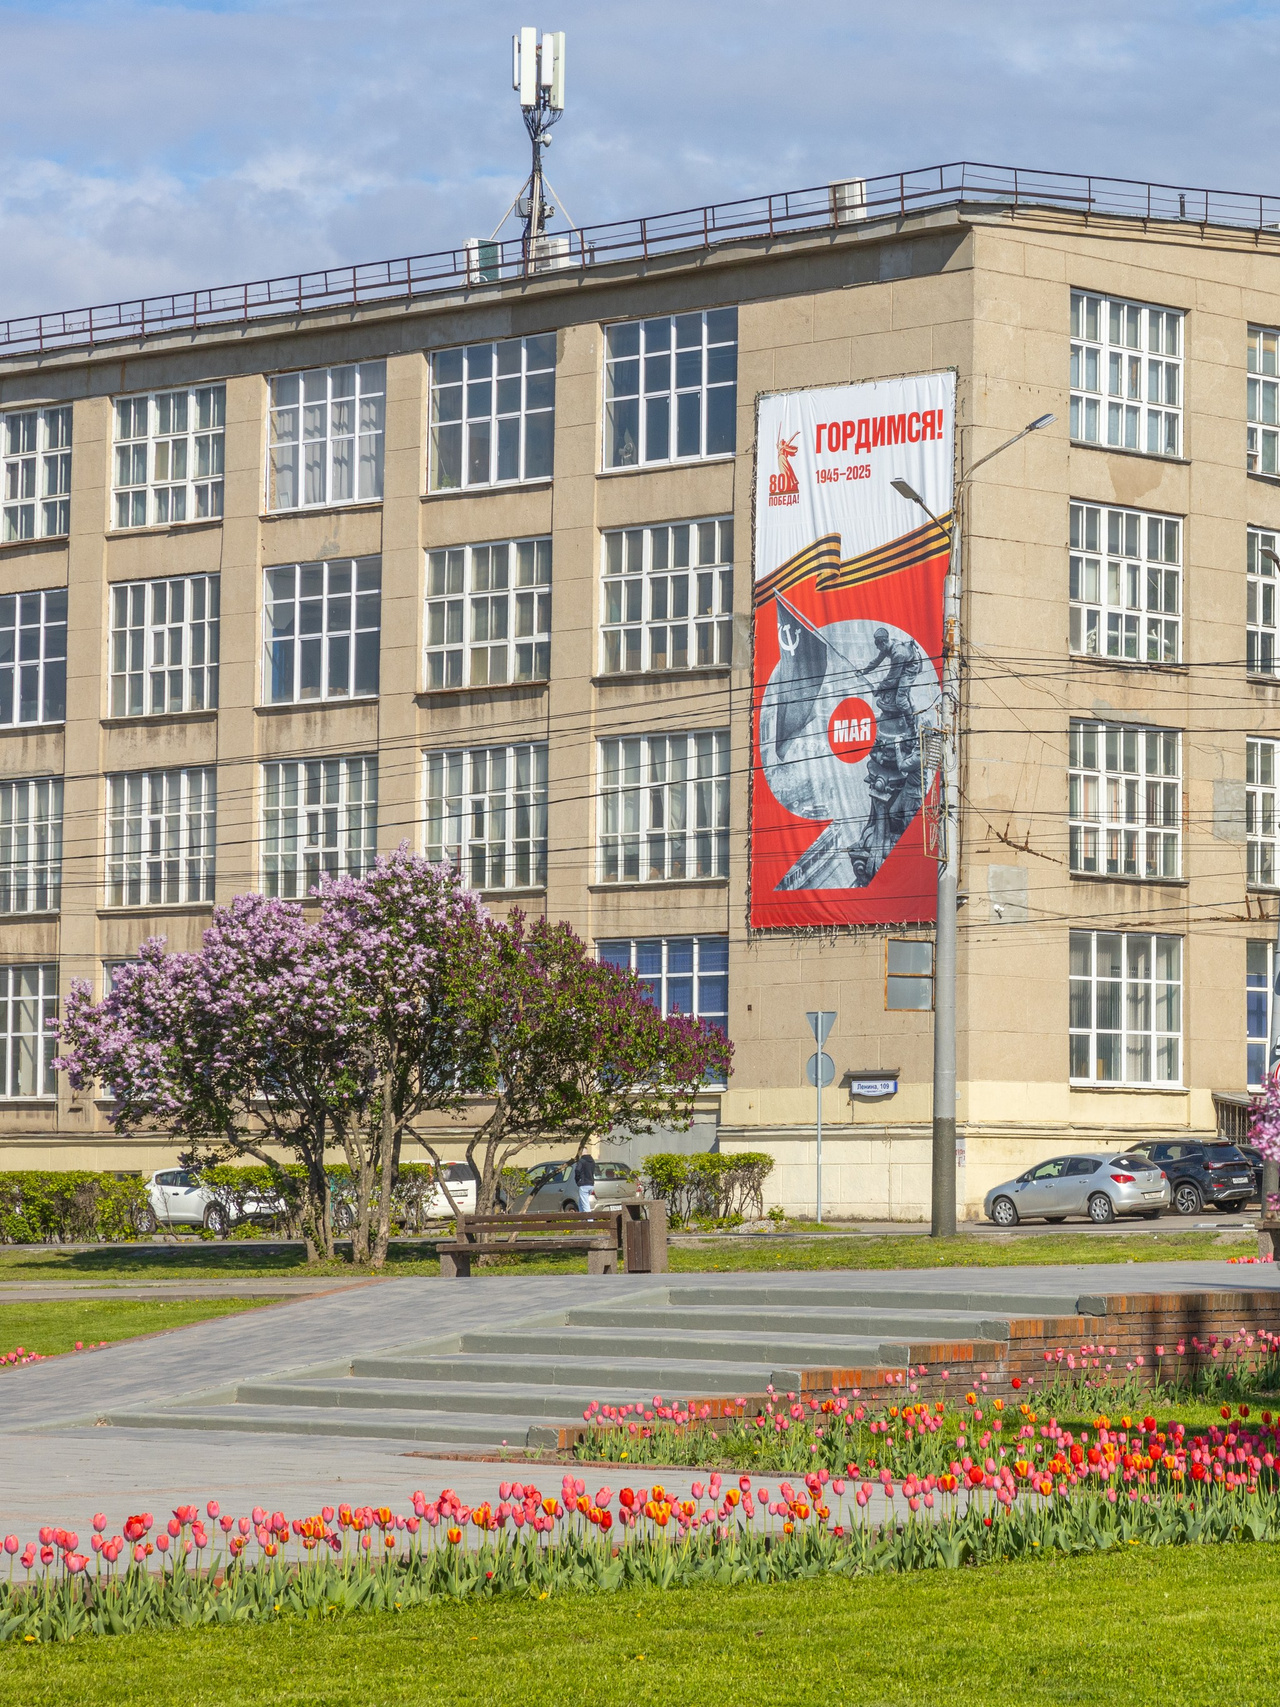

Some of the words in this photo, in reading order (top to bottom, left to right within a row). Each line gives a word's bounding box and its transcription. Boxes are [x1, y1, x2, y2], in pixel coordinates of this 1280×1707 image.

[815, 408, 944, 455] ГОРДИМСЯ!
[769, 473, 786, 493] 80
[768, 494, 800, 507] ПОБЕДА!
[833, 718, 871, 743] МАЯ
